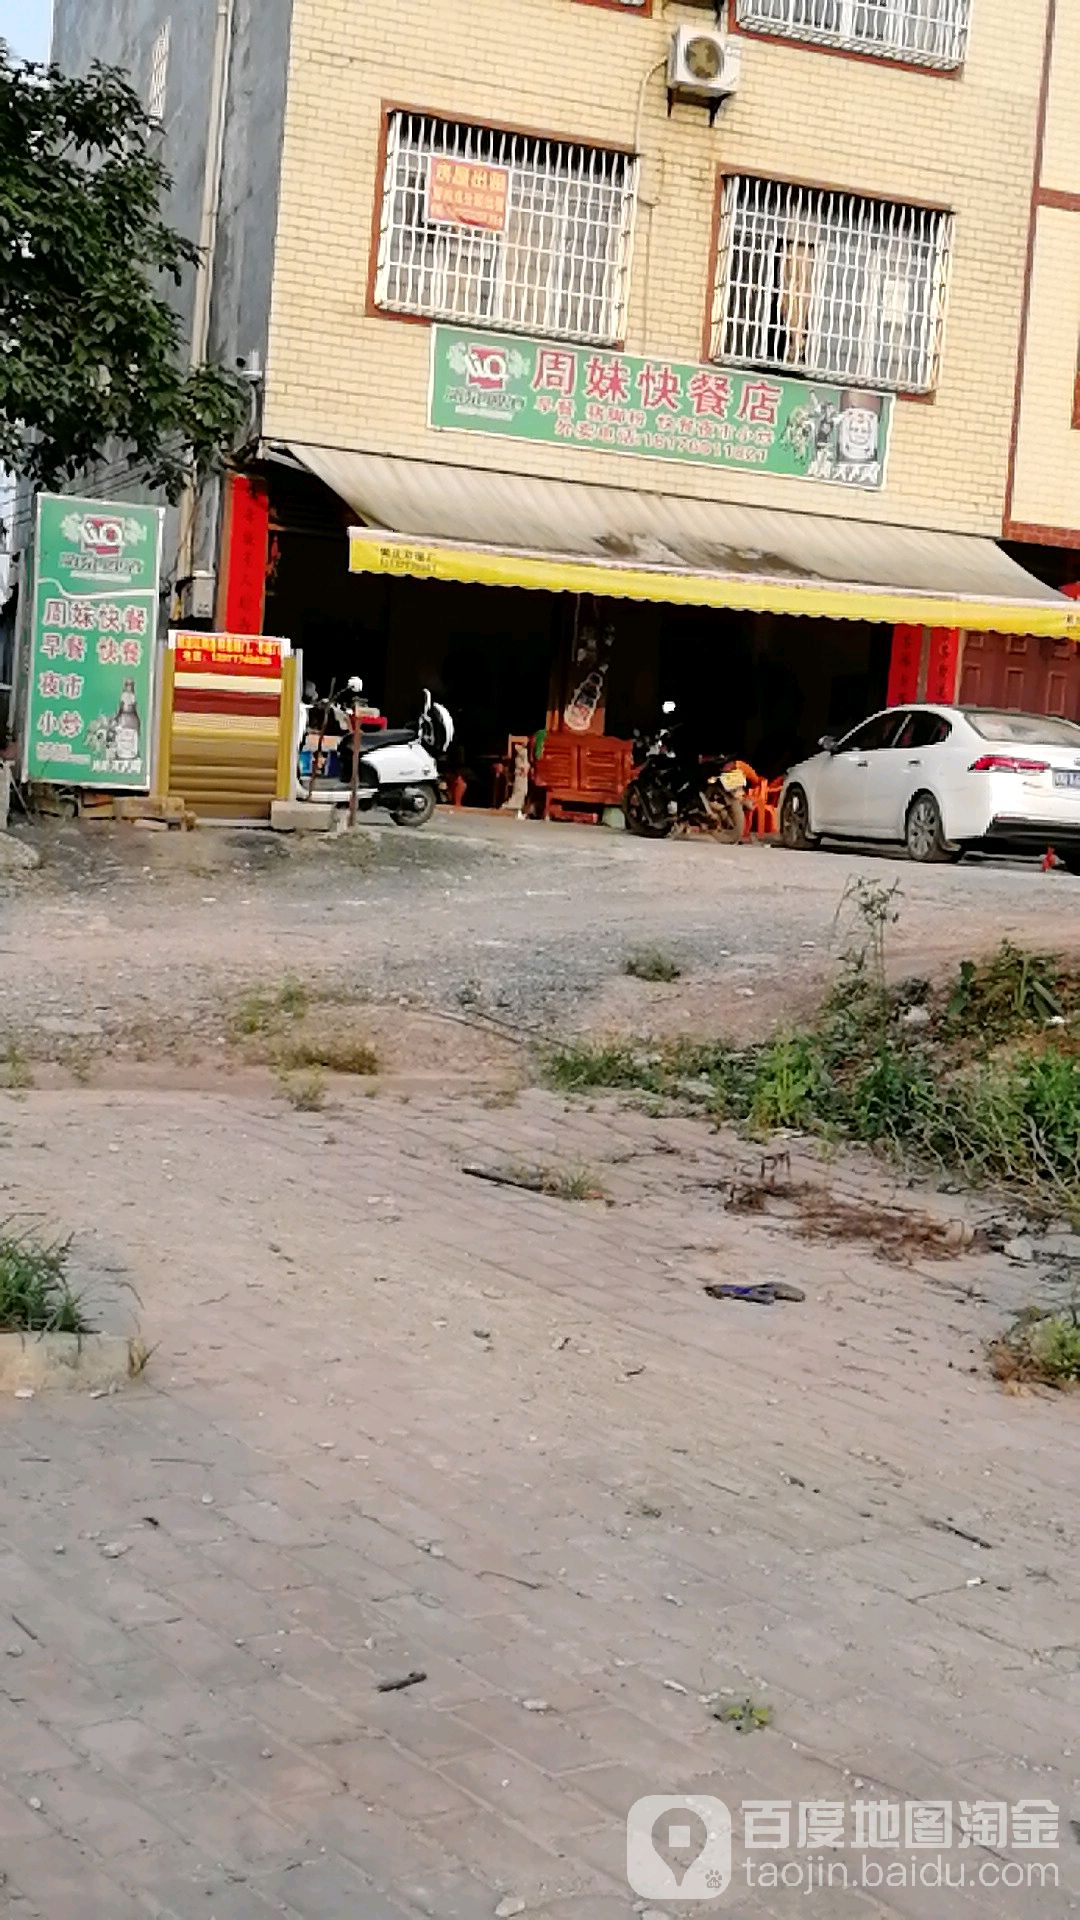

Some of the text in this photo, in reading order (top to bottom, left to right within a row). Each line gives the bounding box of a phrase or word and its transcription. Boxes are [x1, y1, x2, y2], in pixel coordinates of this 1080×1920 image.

[531, 348, 783, 425] 周妹快餐店
[44, 598, 146, 633] 周妹快餐
[41, 633, 141, 666] 早餐 快餐
[39, 672, 83, 698] 夜市
